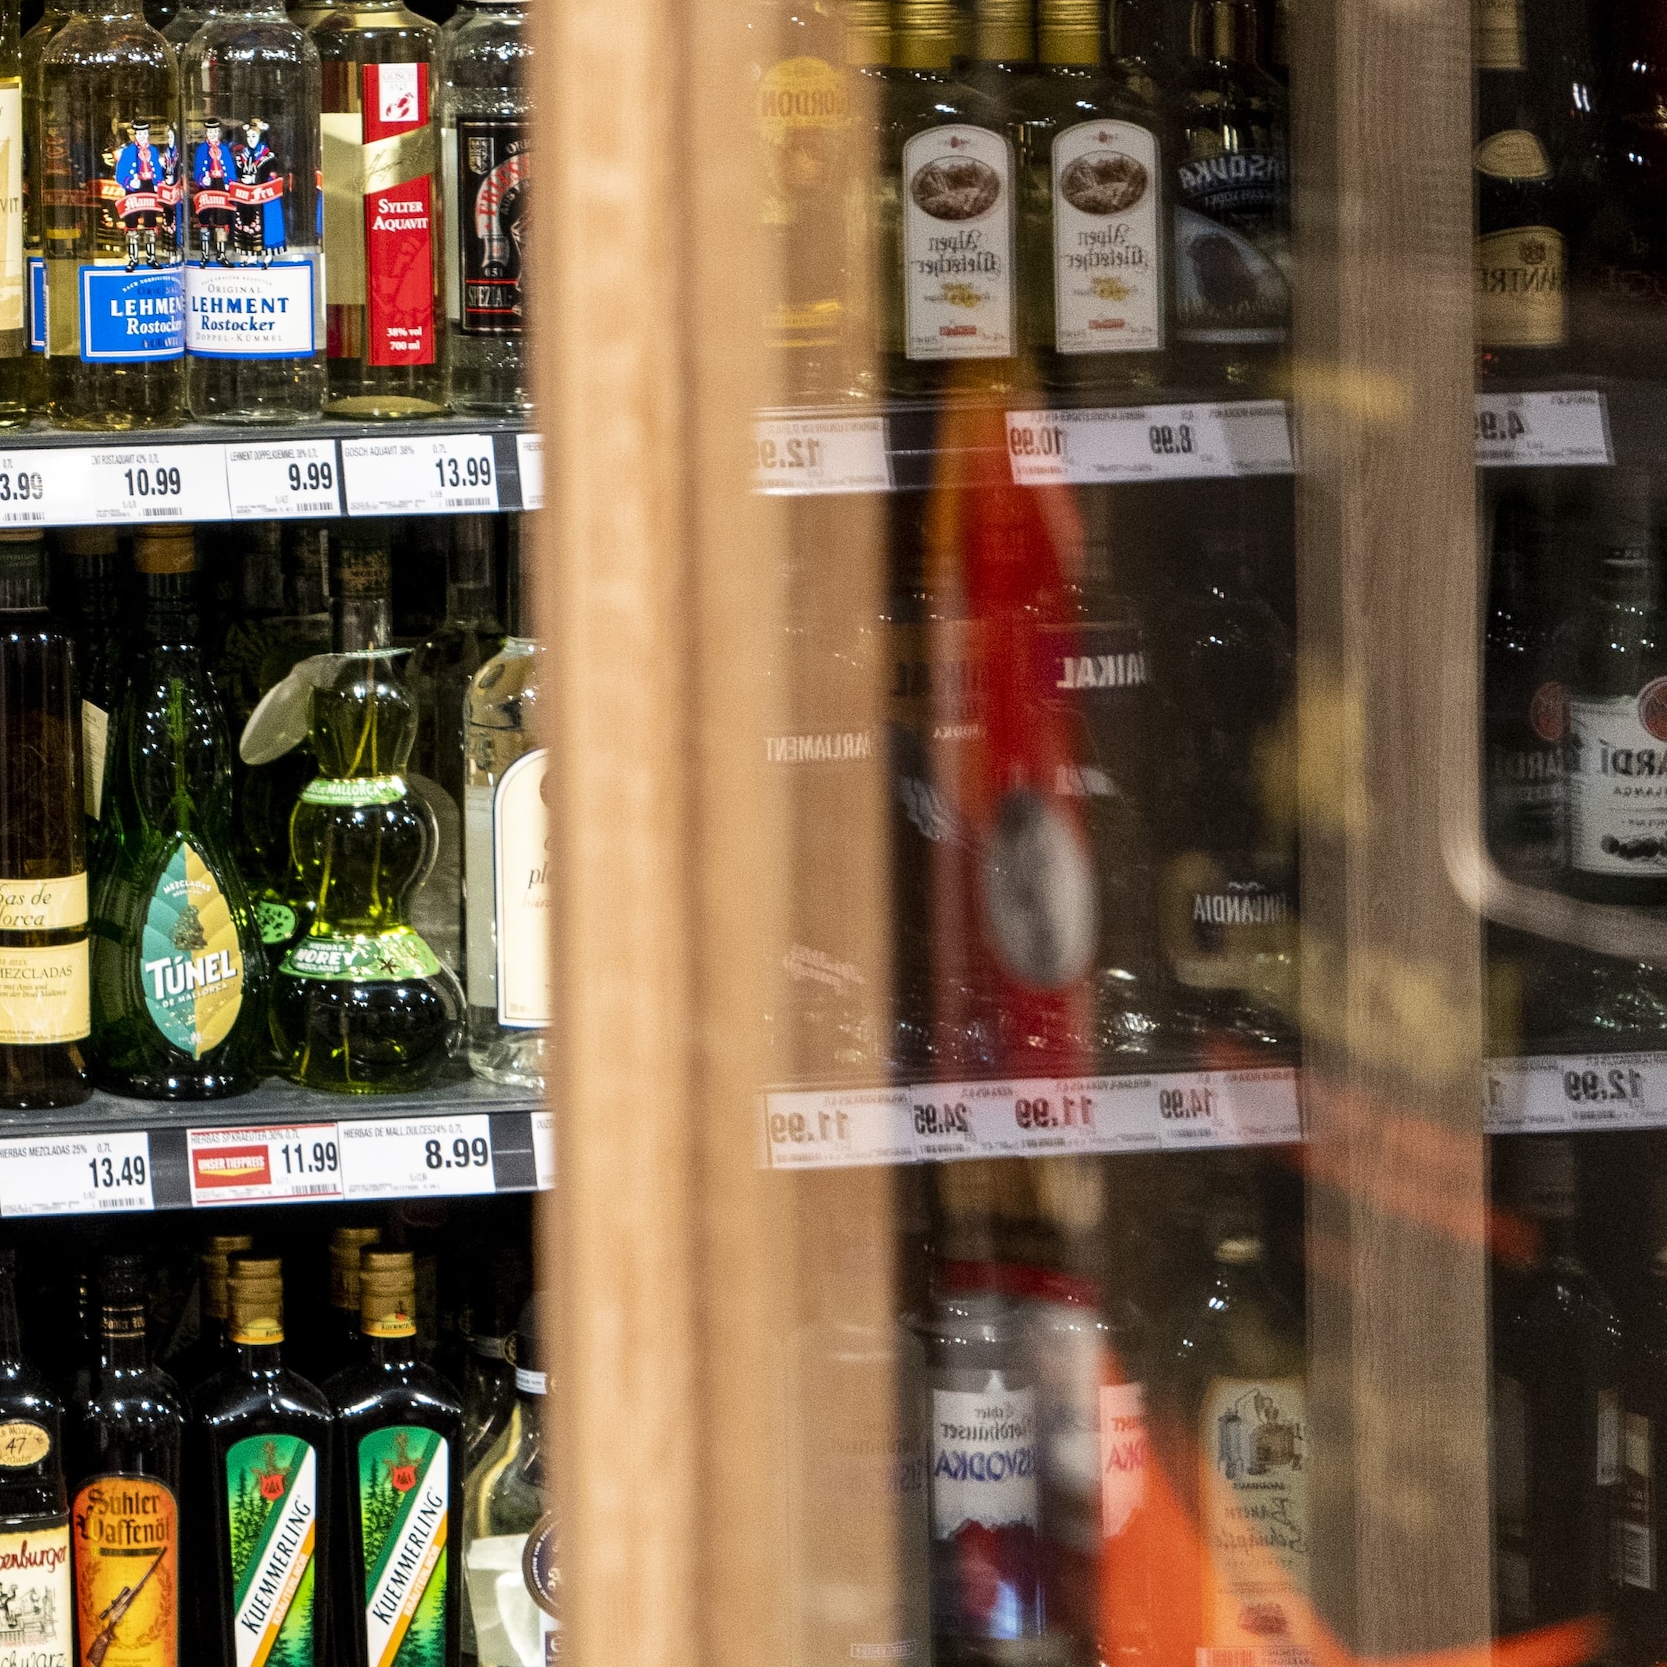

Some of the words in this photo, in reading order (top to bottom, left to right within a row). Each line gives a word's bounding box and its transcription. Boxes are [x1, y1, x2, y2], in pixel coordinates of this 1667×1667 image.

[378, 199, 422, 215] SYLTER
[373, 215, 428, 230] AQUAVIT
[193, 297, 289, 315] LEHMENT
[201, 315, 275, 333] Rostocker
[124, 467, 181, 497] 10.99
[289, 463, 332, 491] 9.99
[435, 457, 491, 488] 13.99
[29, 890, 51, 906] de
[147, 949, 238, 1002] TÚNEL
[282, 1142, 337, 1175] 11.99
[425, 1136, 488, 1170] 8.99
[88, 1154, 145, 1188] 13.49
[375, 1488, 443, 1627] KUEMMERLING
